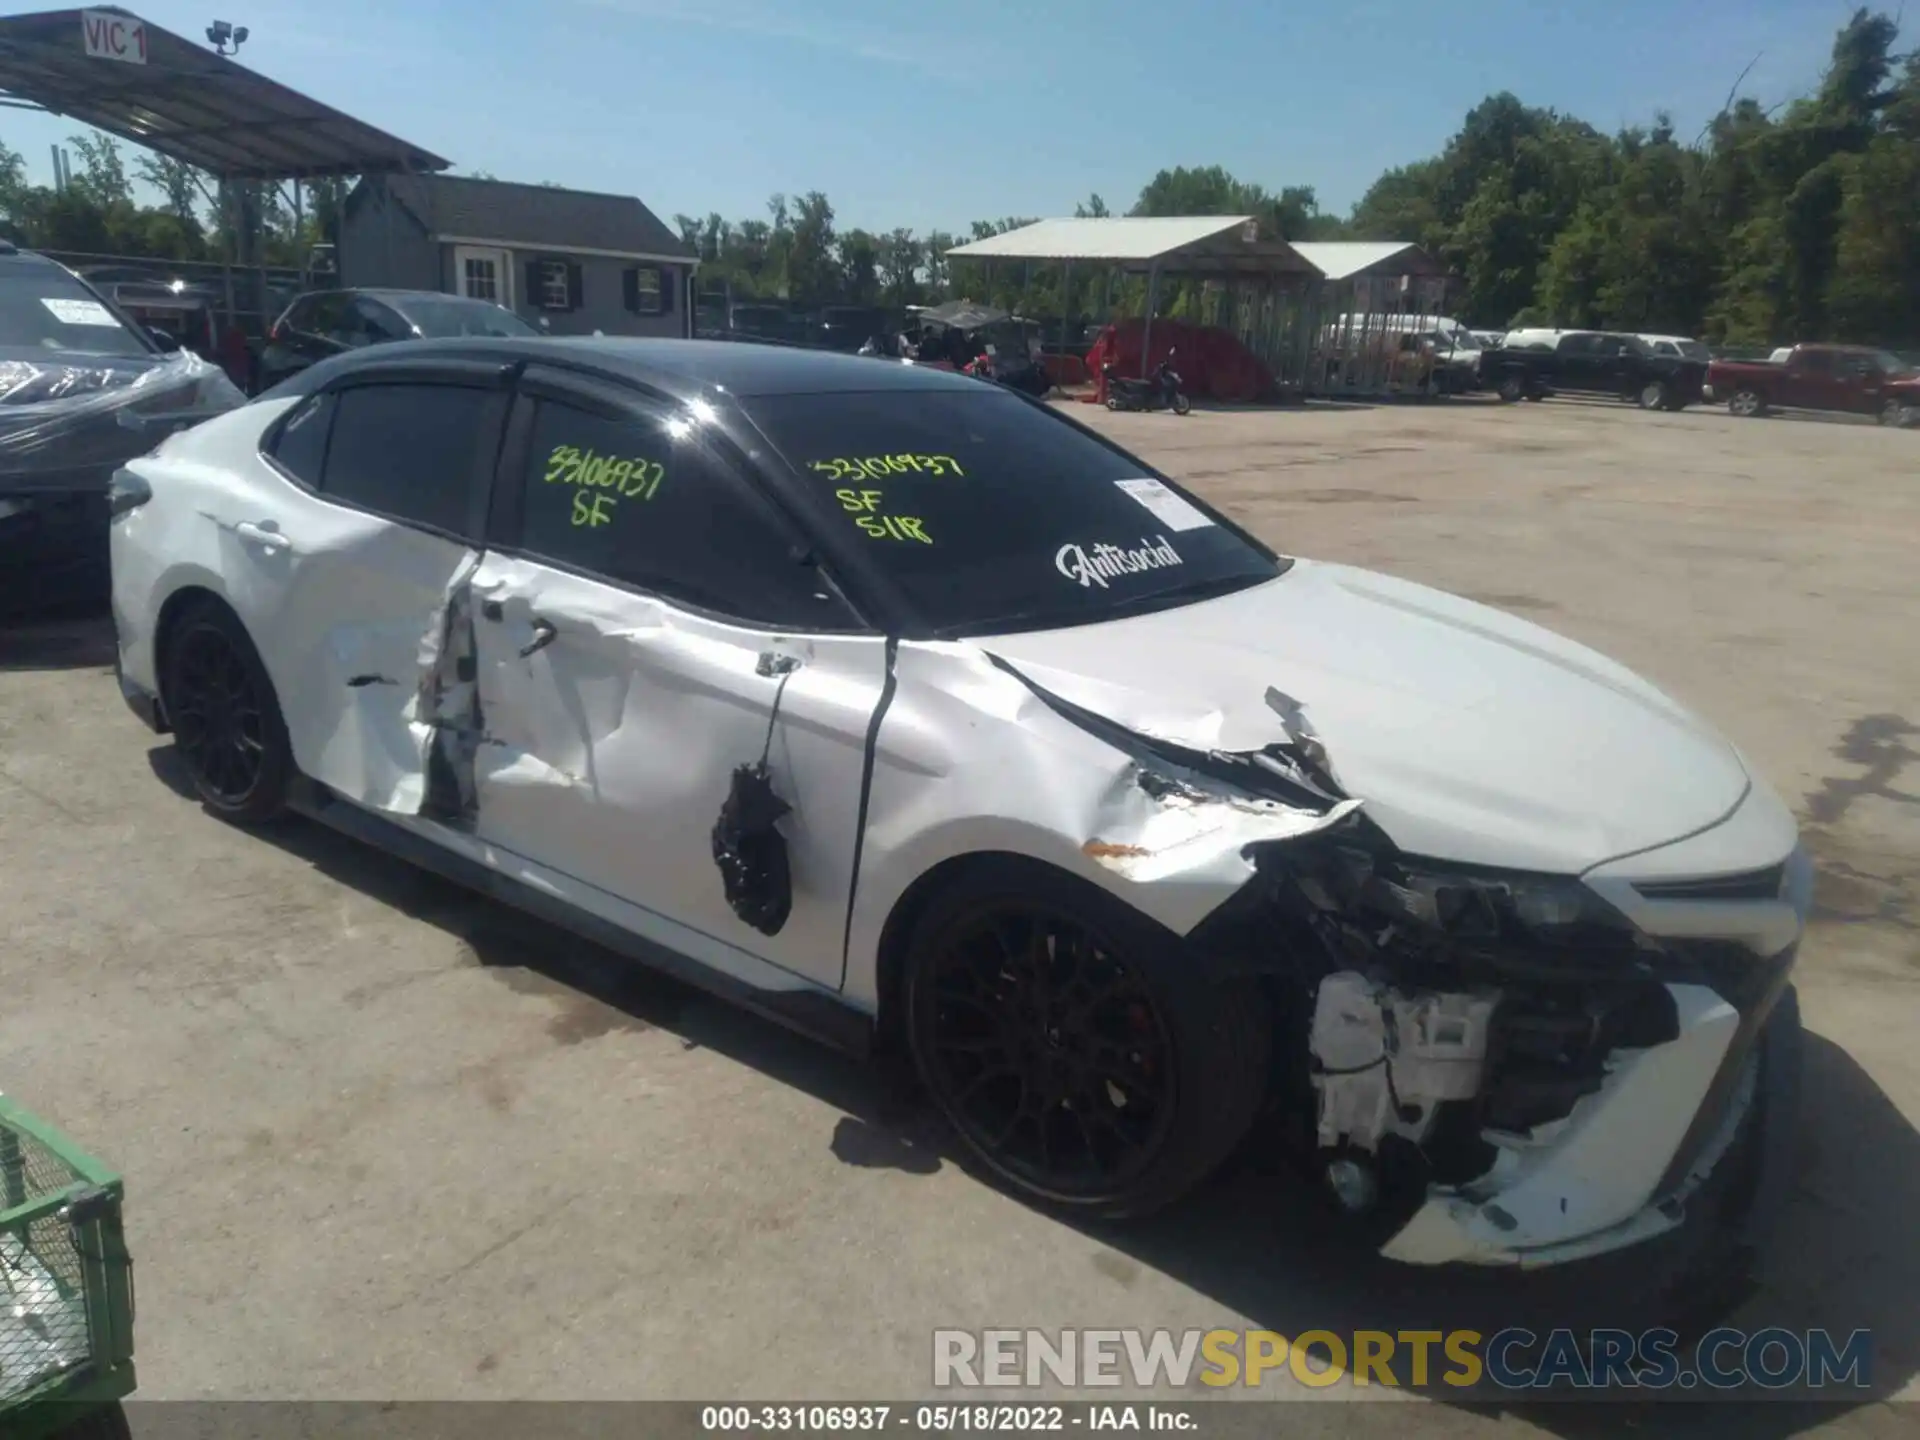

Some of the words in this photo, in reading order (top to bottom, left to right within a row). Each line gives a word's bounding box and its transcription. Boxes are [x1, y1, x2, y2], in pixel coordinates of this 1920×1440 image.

[85, 18, 128, 55] VIC
[132, 26, 145, 58] 1
[544, 445, 664, 500] 33106937
[571, 489, 617, 527] SF
[836, 489, 882, 511] SF
[1055, 534, 1183, 588] Antisocial
